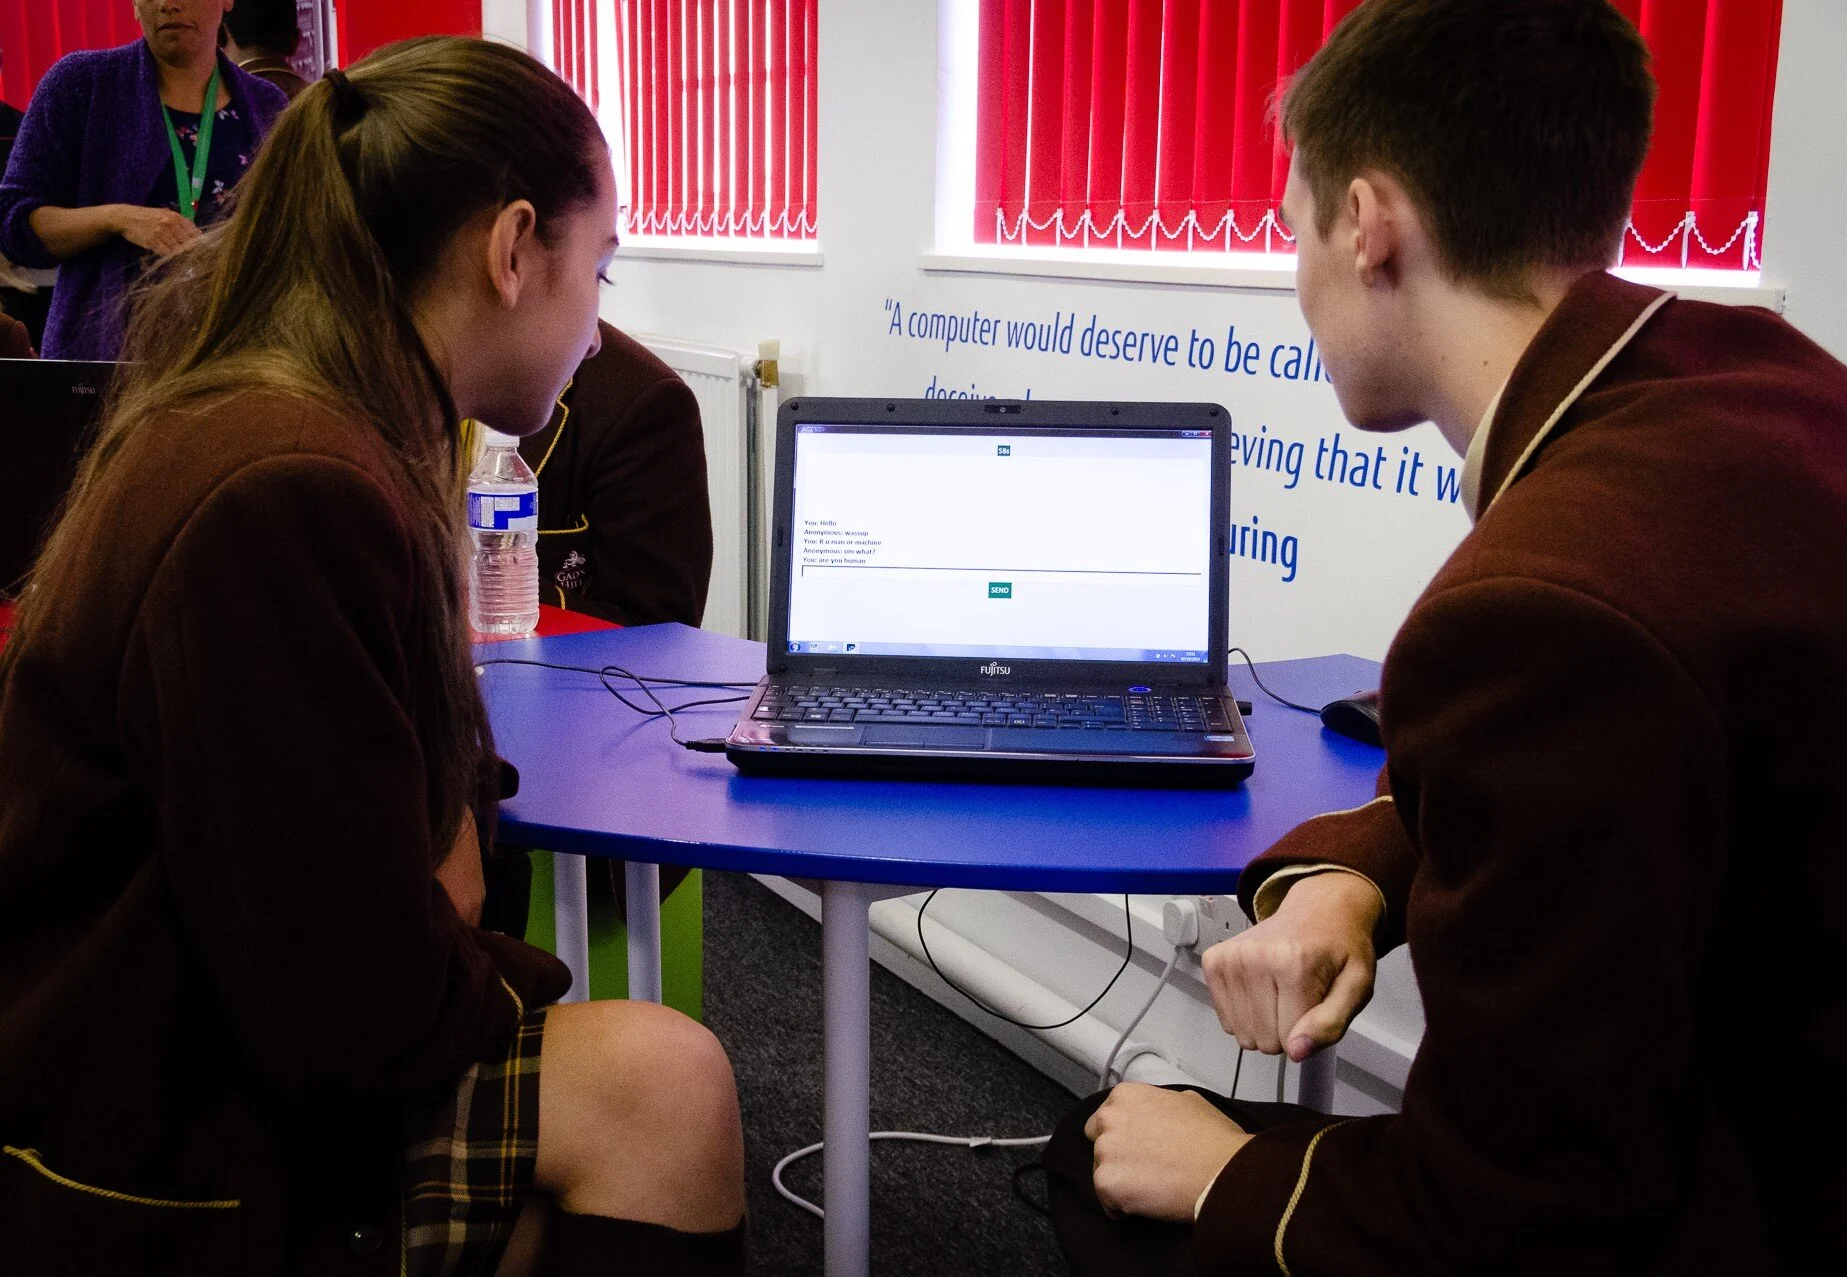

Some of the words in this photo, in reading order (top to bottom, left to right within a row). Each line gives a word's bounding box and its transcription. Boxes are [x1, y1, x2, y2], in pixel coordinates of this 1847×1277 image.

[907, 310, 1001, 353] computer
[1007, 313, 1074, 355] would
[1081, 316, 1179, 367] deserve
[1188, 329, 1214, 370] to
[1225, 326, 1260, 376] be
[1270, 337, 1333, 384] call
[1315, 432, 1388, 490] that
[1396, 447, 1423, 496] it
[803, 529, 843, 537] Anonymous:
[802, 547, 843, 555] Anonymous:
[980, 661, 1011, 677] FUJITSU
